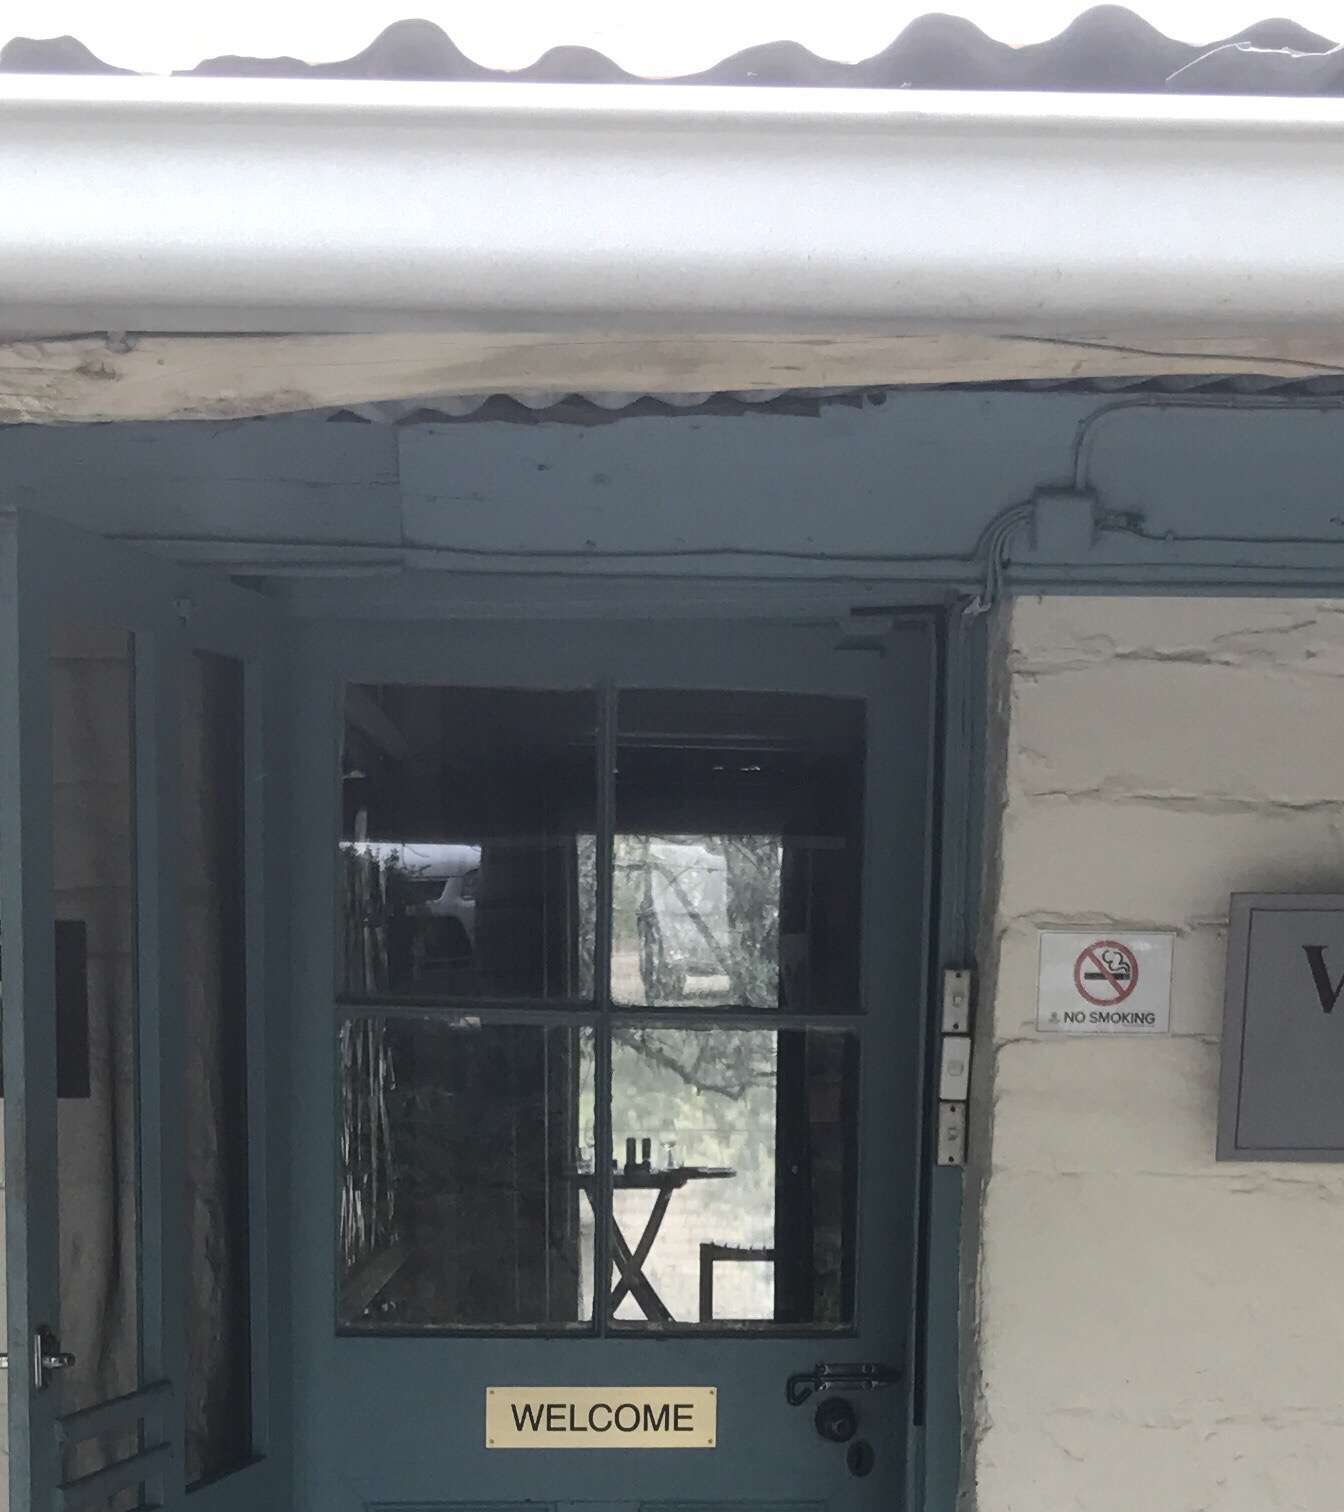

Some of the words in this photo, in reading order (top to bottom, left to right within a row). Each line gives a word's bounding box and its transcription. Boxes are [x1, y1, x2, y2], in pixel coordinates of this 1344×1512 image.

[1063, 1011, 1086, 1024] NO
[1089, 1011, 1156, 1025] SMOKING
[511, 1403, 694, 1433] WELCOME
